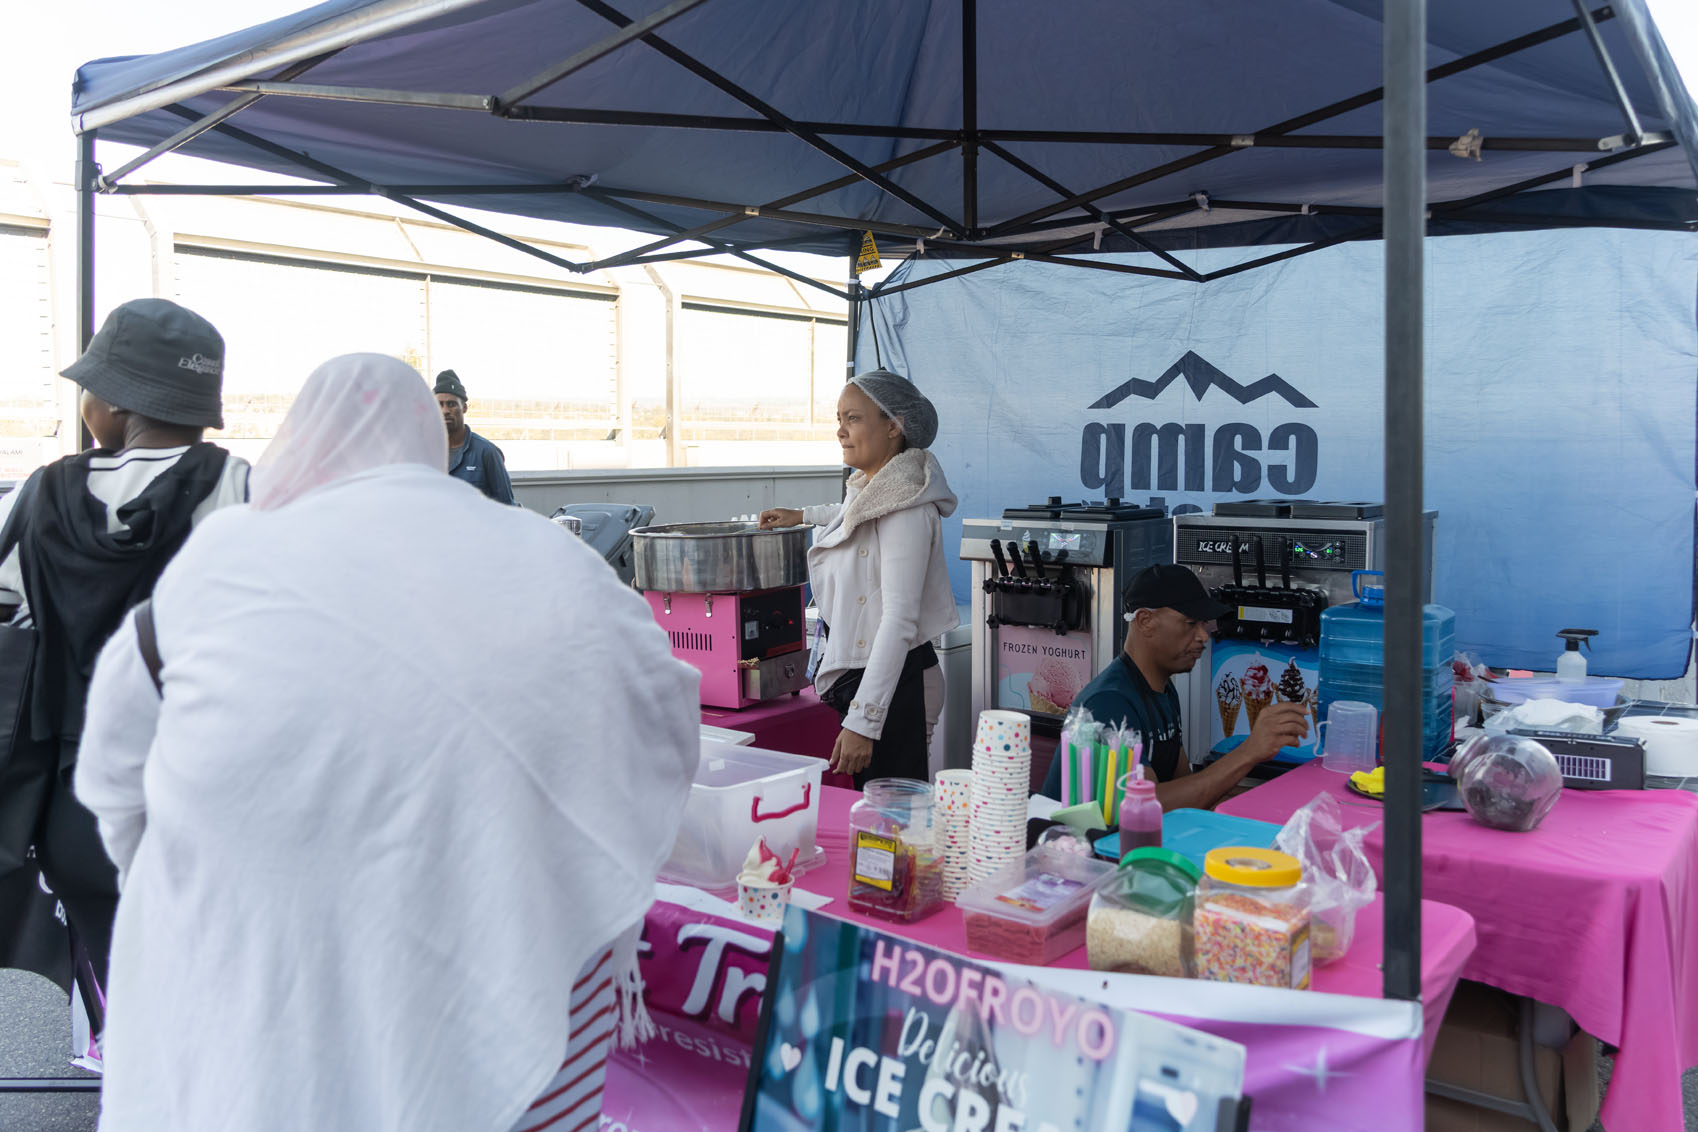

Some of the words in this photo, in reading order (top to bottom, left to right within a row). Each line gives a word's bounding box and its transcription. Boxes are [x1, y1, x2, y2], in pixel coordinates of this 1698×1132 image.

[1198, 541, 1213, 552] ICE
[1215, 541, 1249, 553] CREM
[1003, 642, 1038, 655] FROZEN
[1042, 646, 1086, 660] YOGHURT
[677, 923, 771, 1025] Tr
[871, 939, 1115, 1060] H2OFROYO
[655, 1023, 752, 1069] resist
[824, 1036, 906, 1119] ICE
[897, 1006, 1029, 1107] Delicious
[918, 1078, 1061, 1132] CRE
